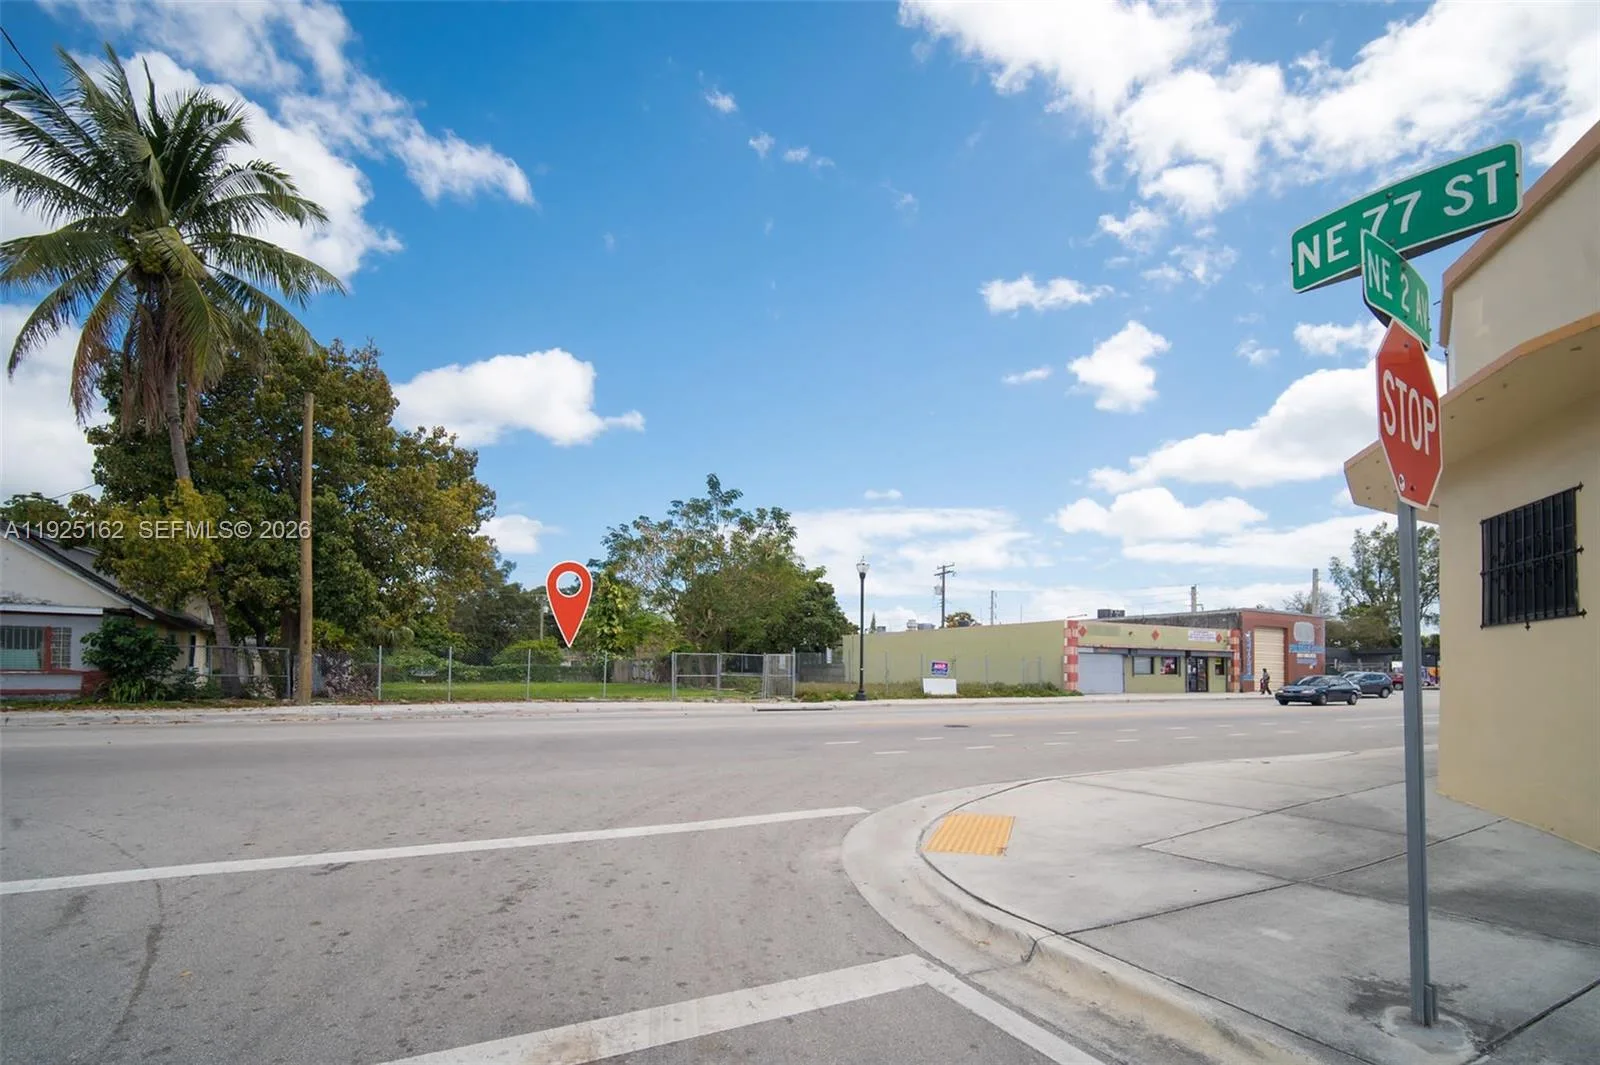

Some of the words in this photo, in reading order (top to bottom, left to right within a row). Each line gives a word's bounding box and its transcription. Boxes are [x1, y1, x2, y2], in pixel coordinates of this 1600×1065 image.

[1297, 220, 1349, 276] NE
[1362, 190, 1422, 236] 77
[1443, 160, 1507, 216] ST
[1367, 248, 1393, 300] NE
[1400, 272, 1410, 313] 2
[1415, 287, 1429, 331] AV
[1383, 368, 1437, 456] STOP
